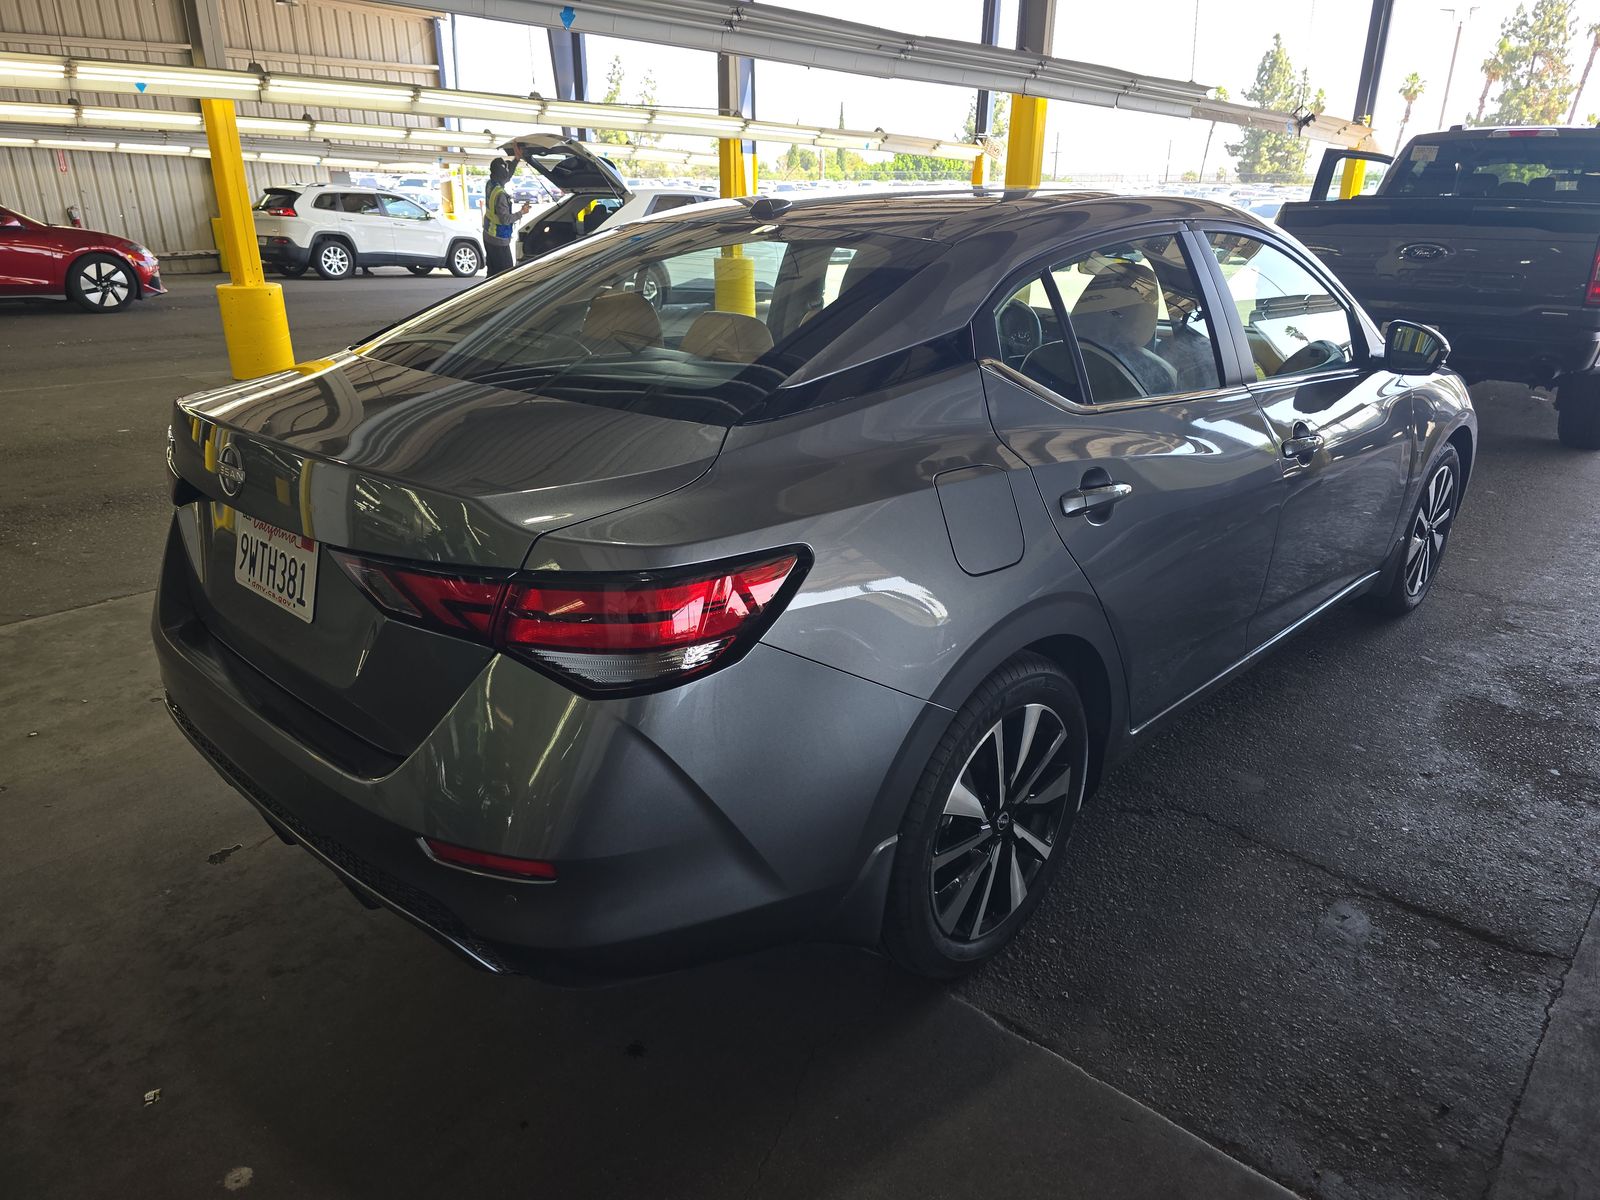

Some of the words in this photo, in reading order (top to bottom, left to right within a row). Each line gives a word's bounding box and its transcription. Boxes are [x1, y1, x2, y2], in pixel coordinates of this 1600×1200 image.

[217, 462, 244, 481] SSAN
[239, 533, 306, 608] 9WTH381
[251, 580, 292, 607] dmv.ca.gov
